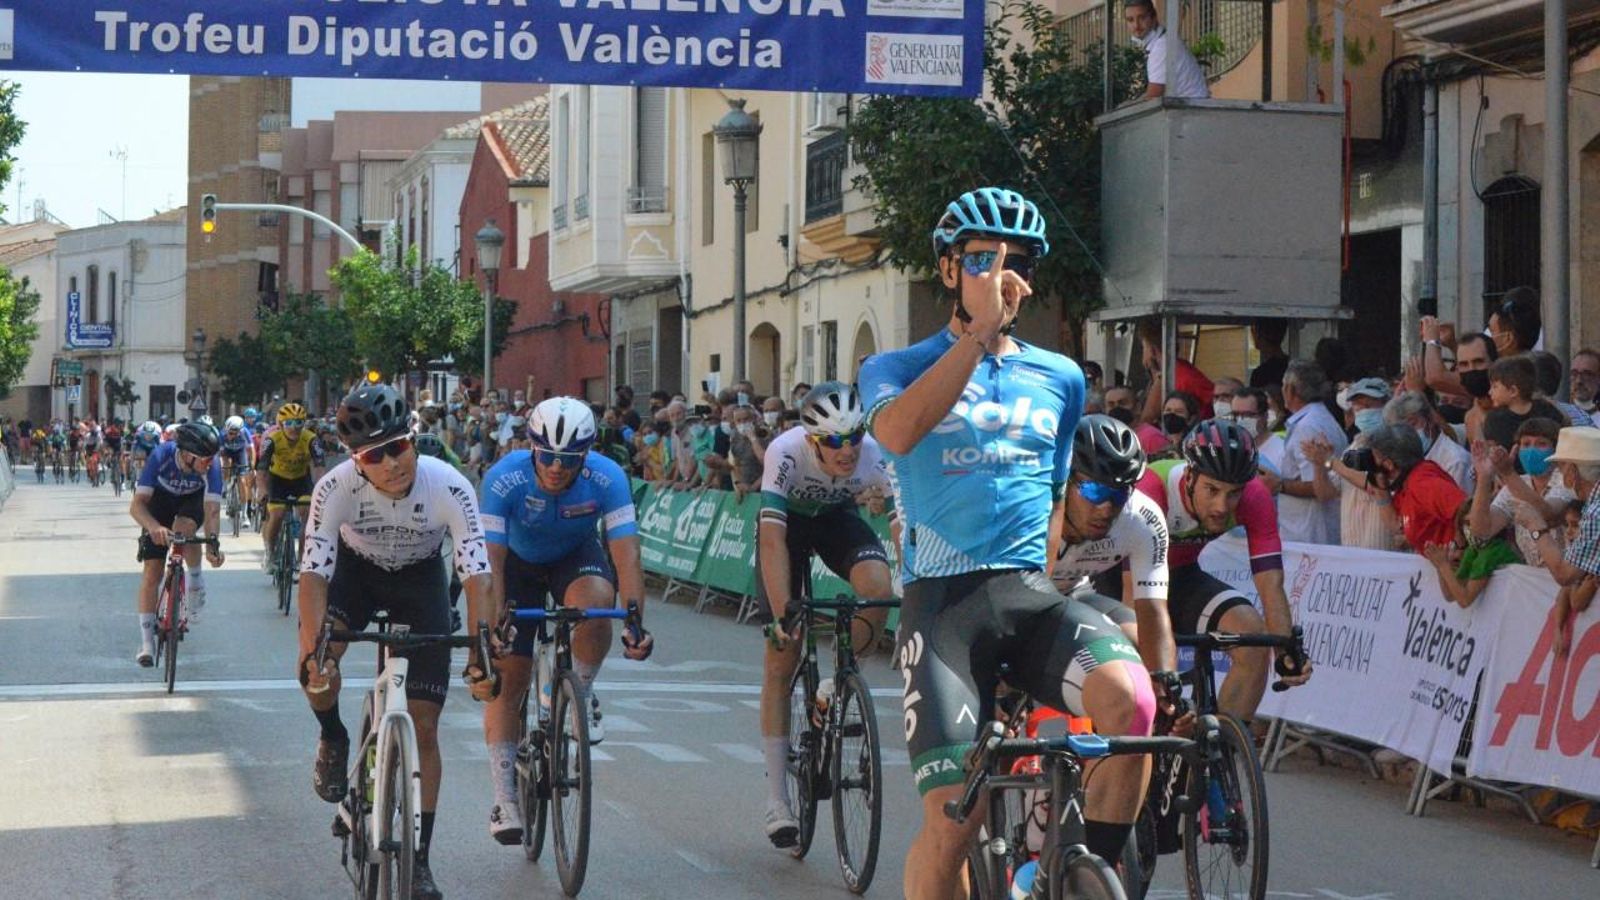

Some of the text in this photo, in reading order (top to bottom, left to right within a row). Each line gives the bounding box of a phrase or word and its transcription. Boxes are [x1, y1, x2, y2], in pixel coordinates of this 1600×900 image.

[95, 11, 782, 68] Trofeu Diputació València
[889, 42, 962, 60] GENERALITAT
[889, 59, 962, 76] VALENCIANA
[1308, 572, 1395, 621] GENERALITAT
[1403, 606, 1475, 677] Valènca
